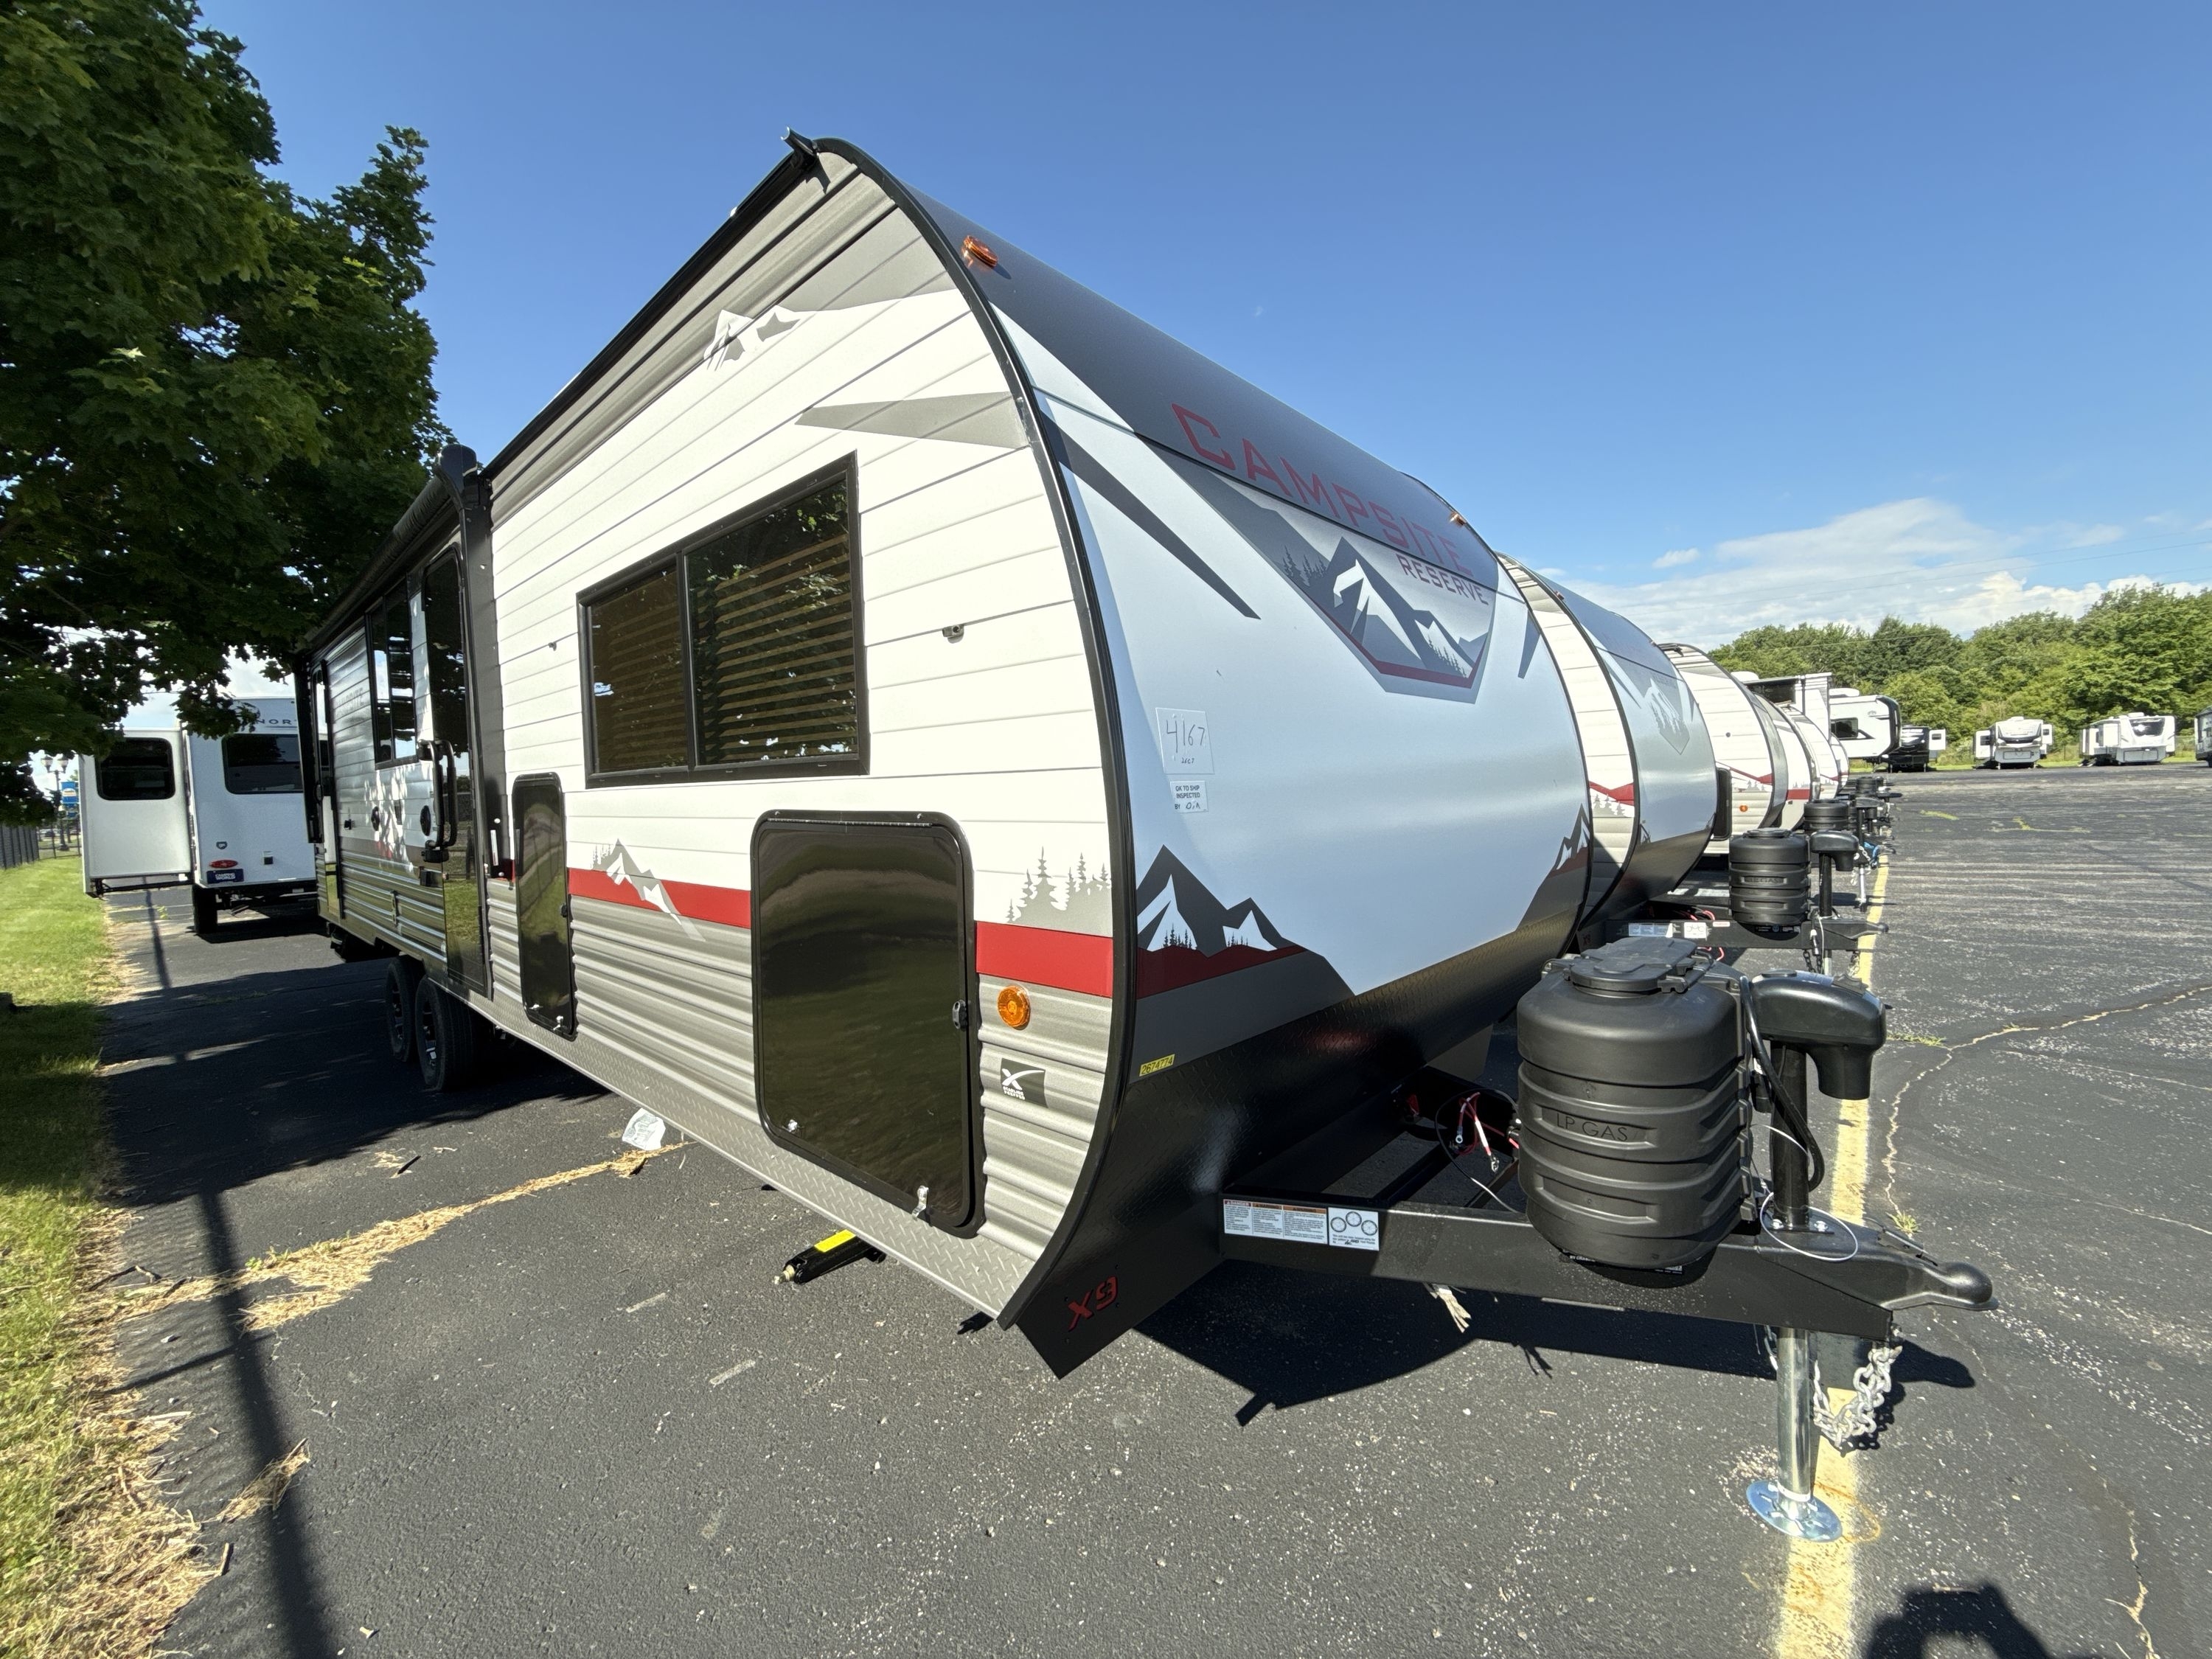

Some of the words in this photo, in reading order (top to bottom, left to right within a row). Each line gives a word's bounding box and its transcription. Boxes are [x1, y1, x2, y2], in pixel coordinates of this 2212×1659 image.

[1172, 403, 1473, 577] CAMPSITE
[1397, 553, 1489, 605] RESERVE
[1166, 719, 1206, 754] 4167
[1556, 1112, 1576, 1130] LP
[1582, 1120, 1628, 1142] GAS
[1068, 1276, 1117, 1332] X9
